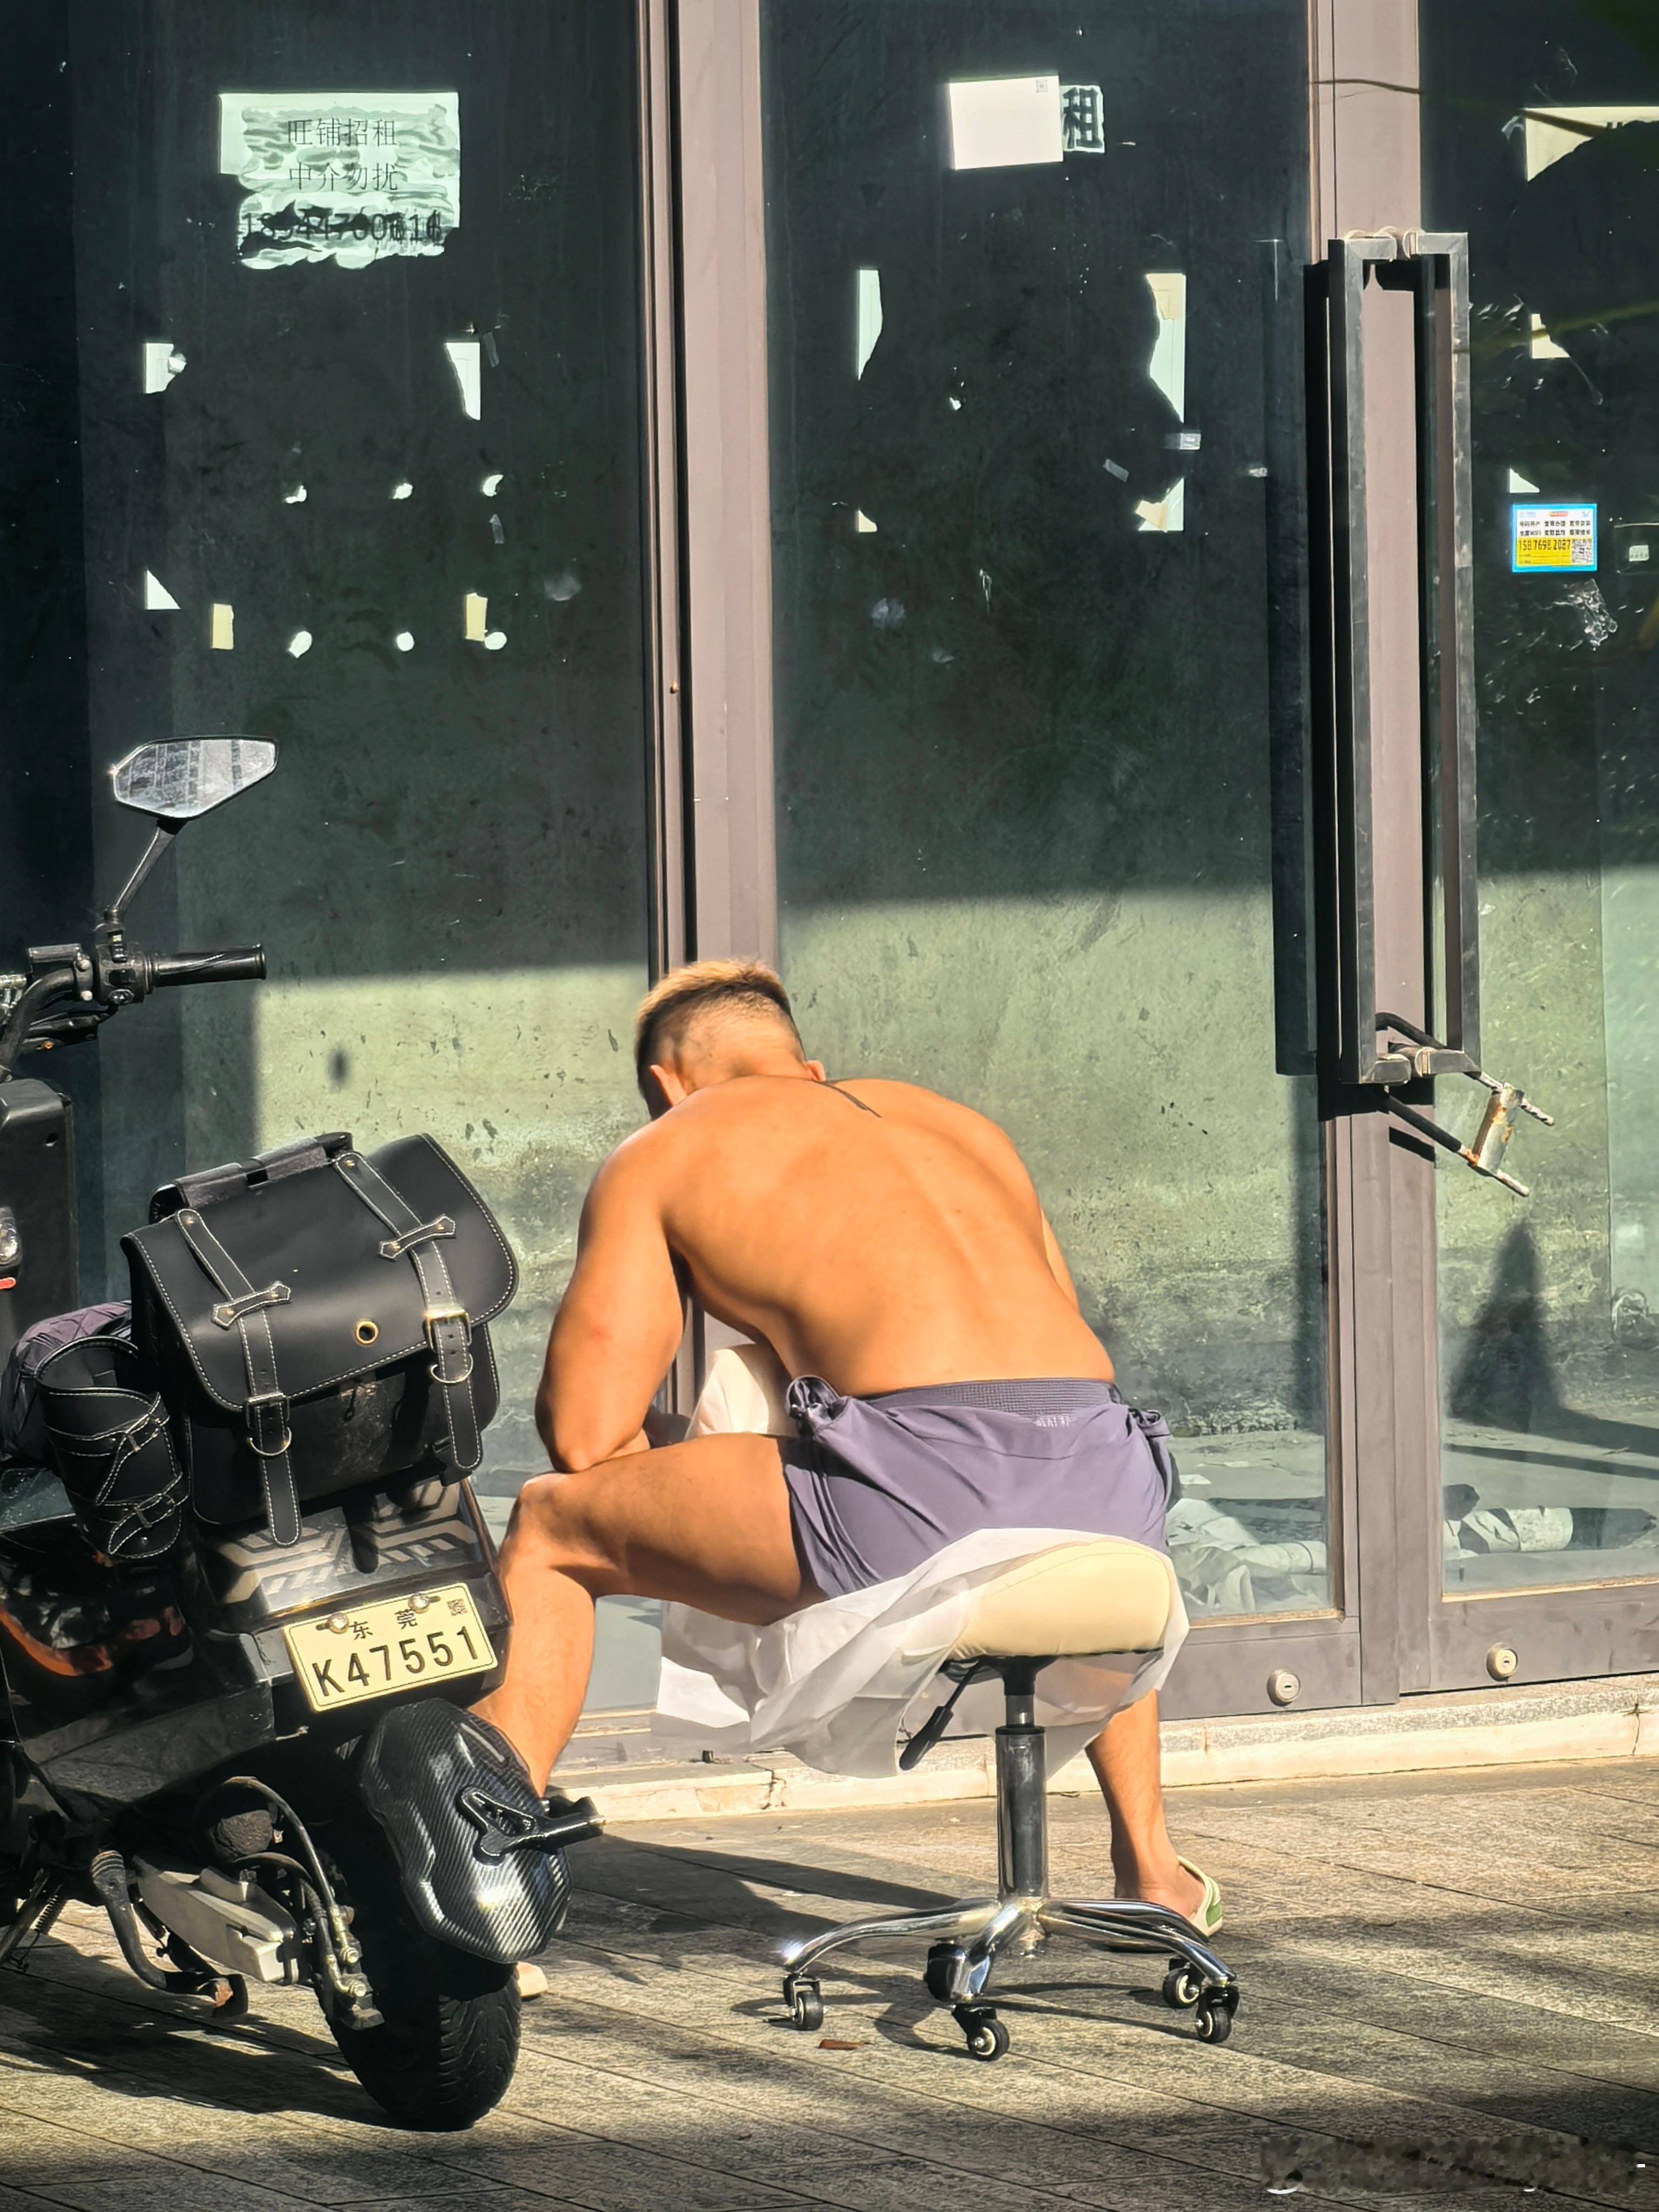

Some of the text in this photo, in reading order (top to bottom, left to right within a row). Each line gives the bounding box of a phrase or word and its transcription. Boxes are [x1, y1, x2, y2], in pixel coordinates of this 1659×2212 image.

[287, 118, 397, 146] 旺铺招租
[289, 162, 398, 191] 中介勿扰
[349, 1608, 418, 1641] 东莞
[312, 1626, 478, 1697] K47551
